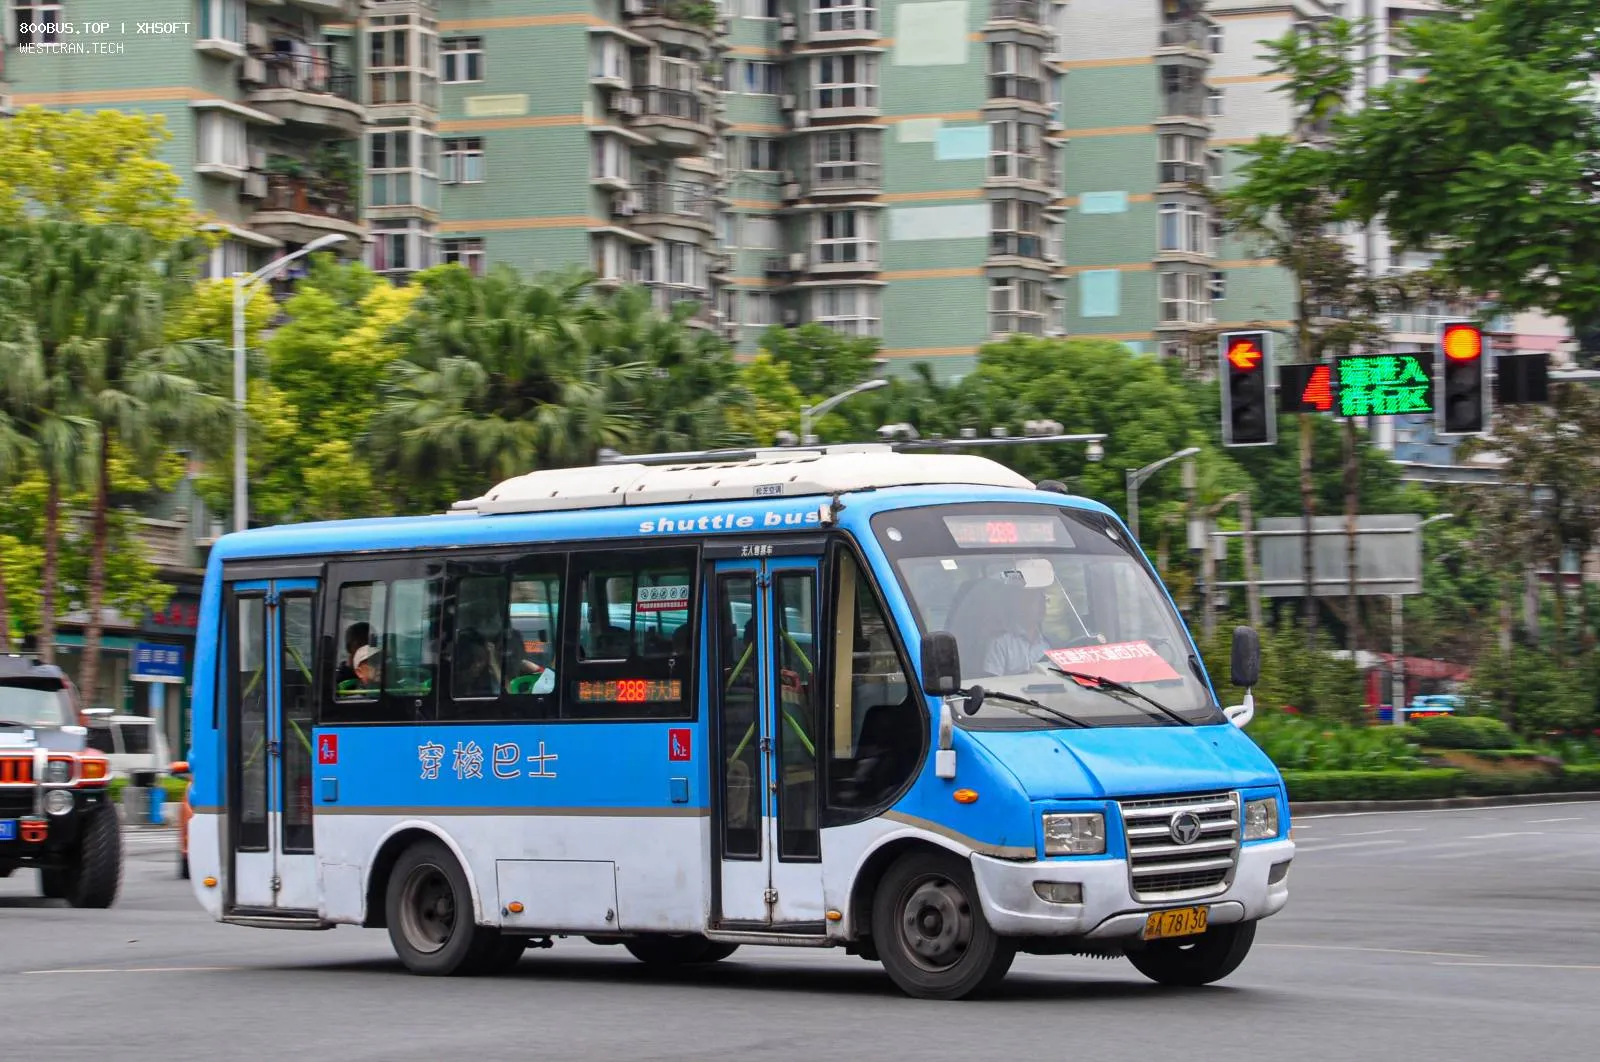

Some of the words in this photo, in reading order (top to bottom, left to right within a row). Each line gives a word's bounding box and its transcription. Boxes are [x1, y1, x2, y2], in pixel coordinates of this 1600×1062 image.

[639, 514, 754, 533] shuttle
[764, 511, 820, 527] bus
[618, 681, 646, 701] 288
[417, 741, 559, 780] 穿梭巴士
